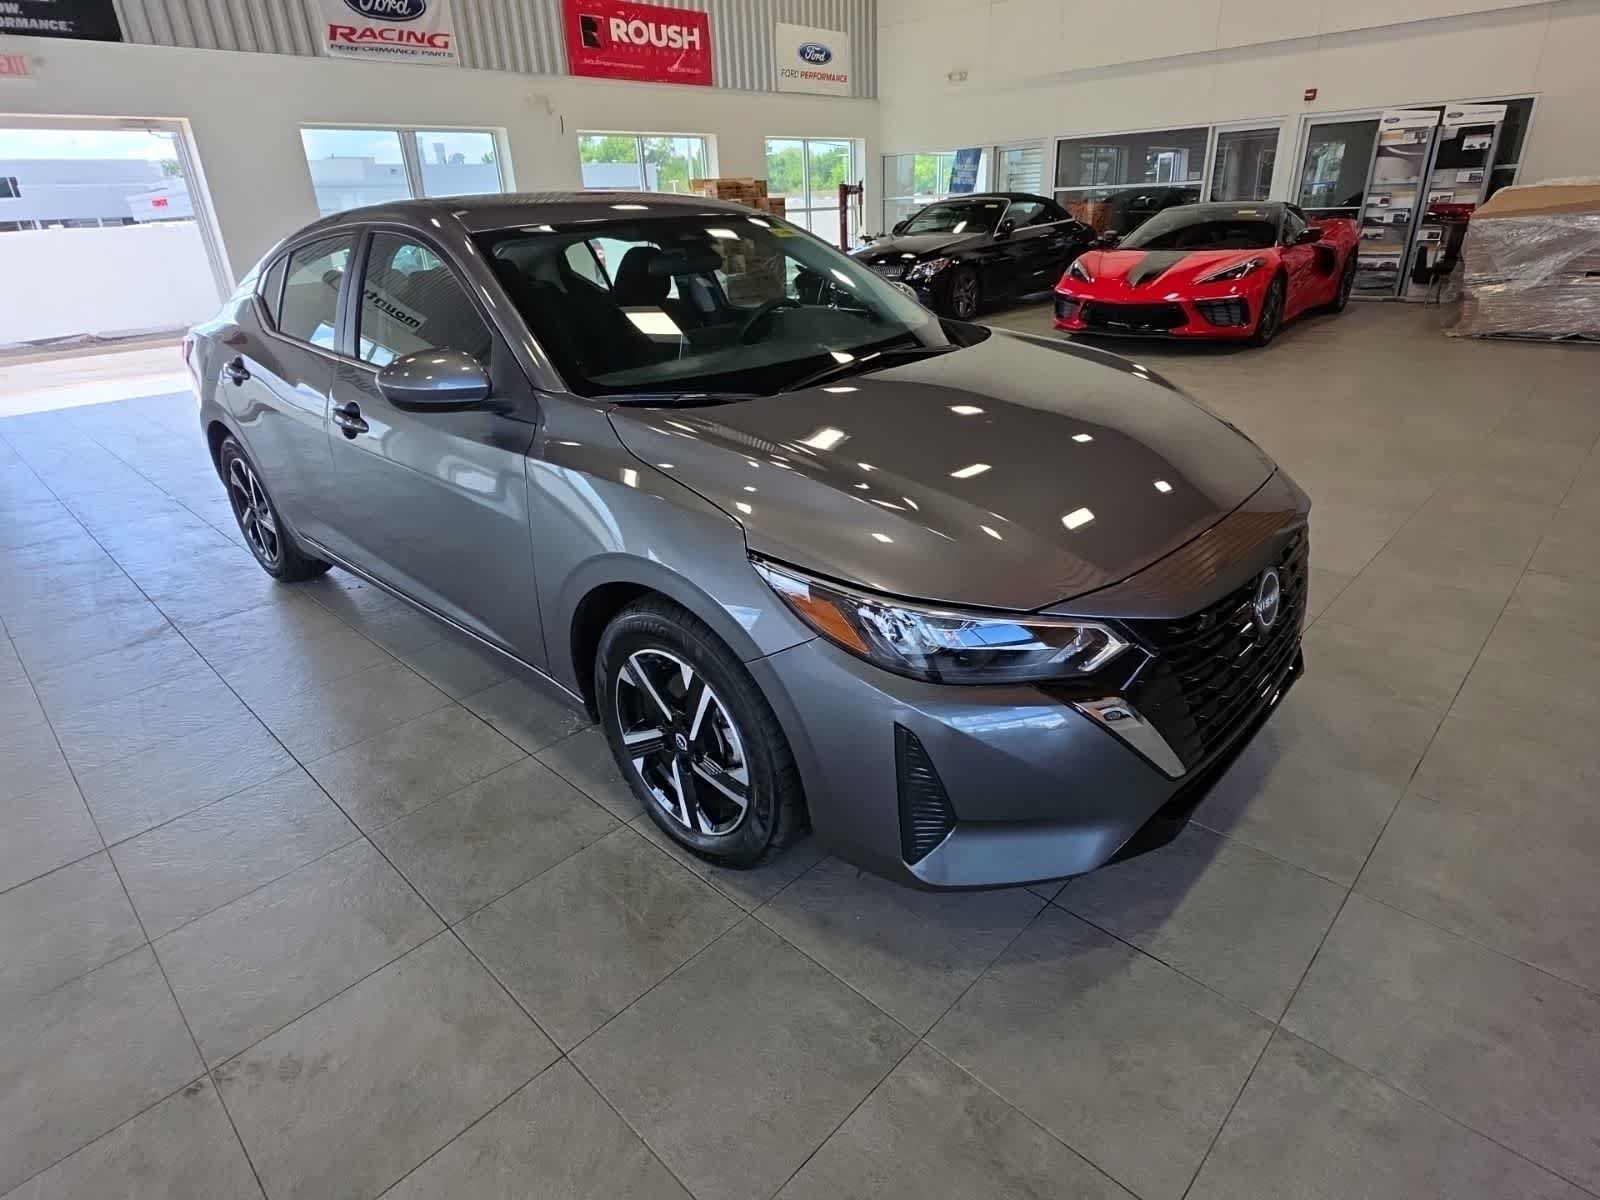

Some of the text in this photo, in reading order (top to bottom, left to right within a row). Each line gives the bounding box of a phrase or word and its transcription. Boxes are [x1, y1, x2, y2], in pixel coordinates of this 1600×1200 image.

[328, 23, 451, 49] RACING
[609, 17, 701, 50] ROUSH
[331, 43, 454, 58] PERFORMANCE PARTS
[804, 41, 826, 61] Ford
[781, 68, 848, 83] FORD PERFORMANCE
